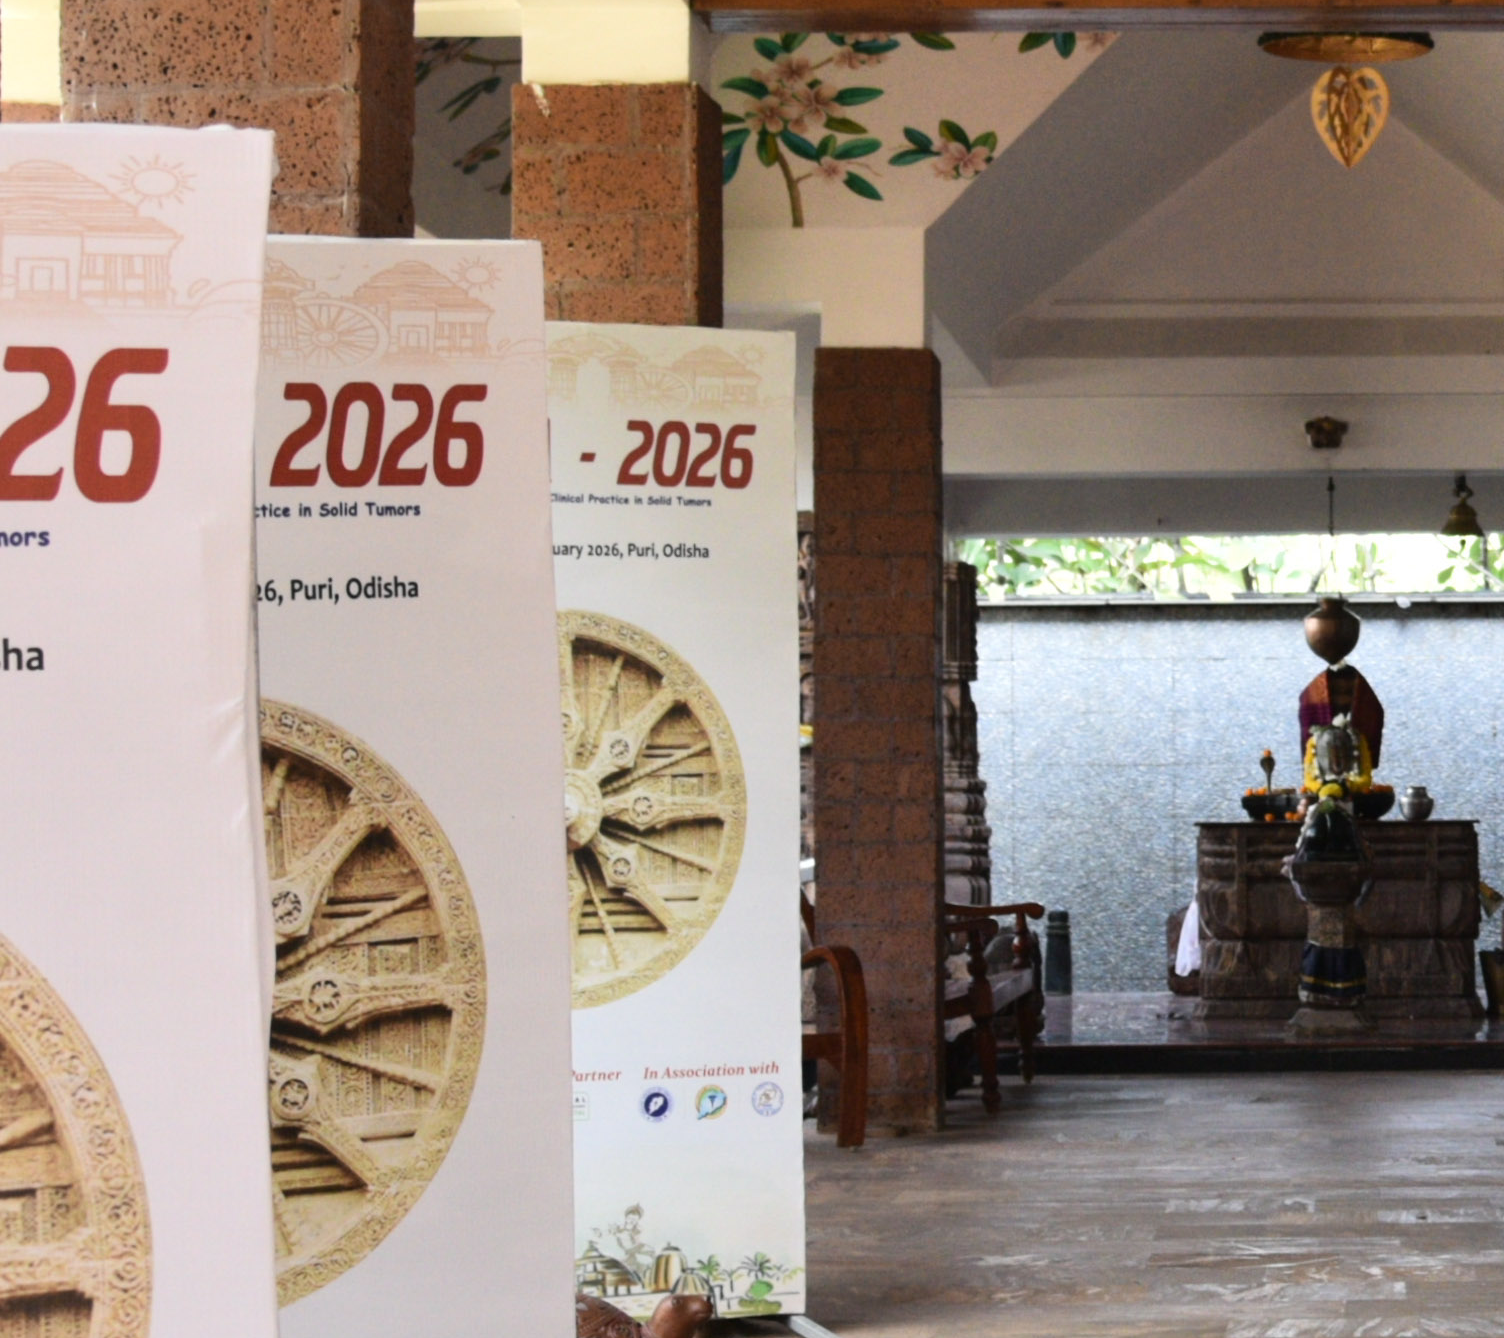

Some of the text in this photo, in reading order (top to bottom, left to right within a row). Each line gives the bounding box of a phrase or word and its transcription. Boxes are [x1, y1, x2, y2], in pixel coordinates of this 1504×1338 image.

[270, 382, 487, 488] 2026
[617, 420, 756, 489] 2026
[589, 494, 629, 504] Practice
[634, 496, 643, 504] in
[648, 496, 672, 505] Solid
[677, 496, 711, 506] Tumors
[254, 502, 420, 518] ctice in Solid Tumors
[551, 543, 709, 559] uary 2026, Puri, Odisha
[257, 576, 418, 606] 26, Puri, Odisha
[644, 1061, 779, 1079] In Association with
